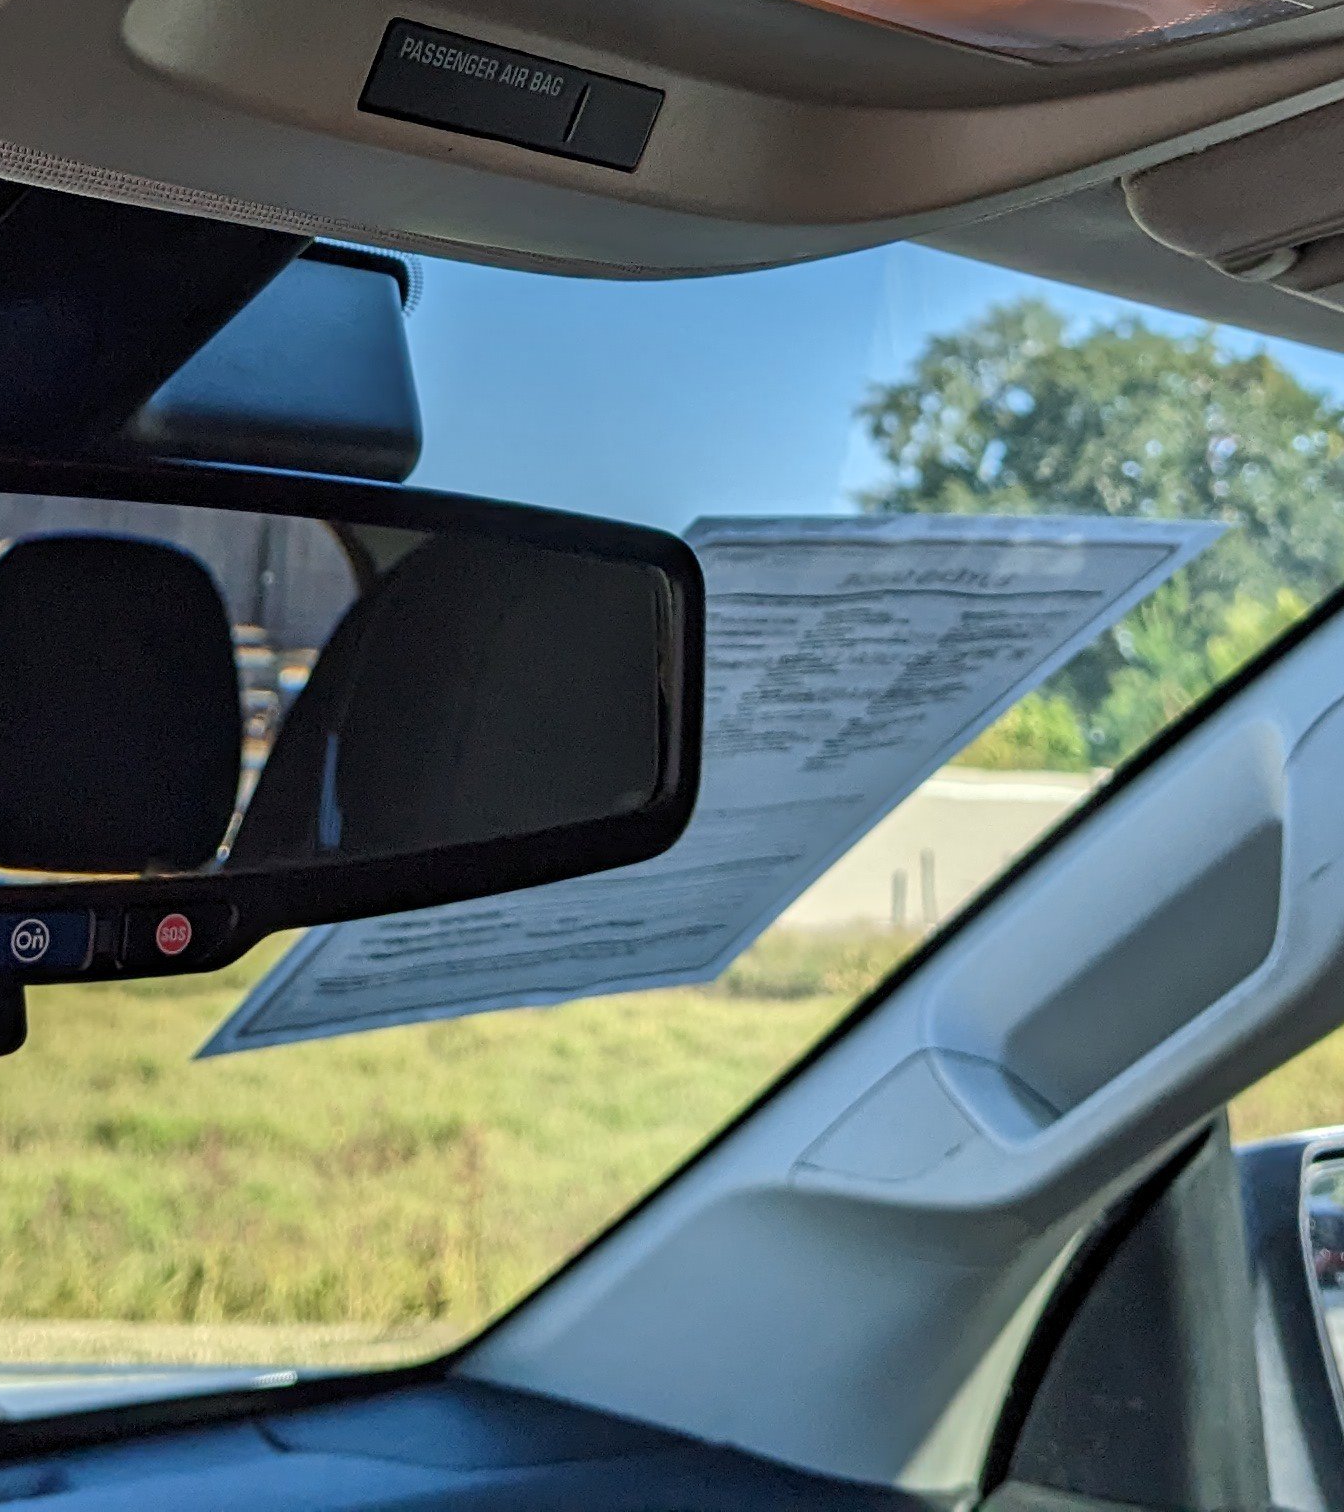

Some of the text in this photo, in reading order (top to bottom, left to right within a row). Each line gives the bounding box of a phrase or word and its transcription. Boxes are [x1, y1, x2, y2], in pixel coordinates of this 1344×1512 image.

[400, 37, 565, 97] PASSENGER AIR BAG
[162, 926, 188, 943] SOS
